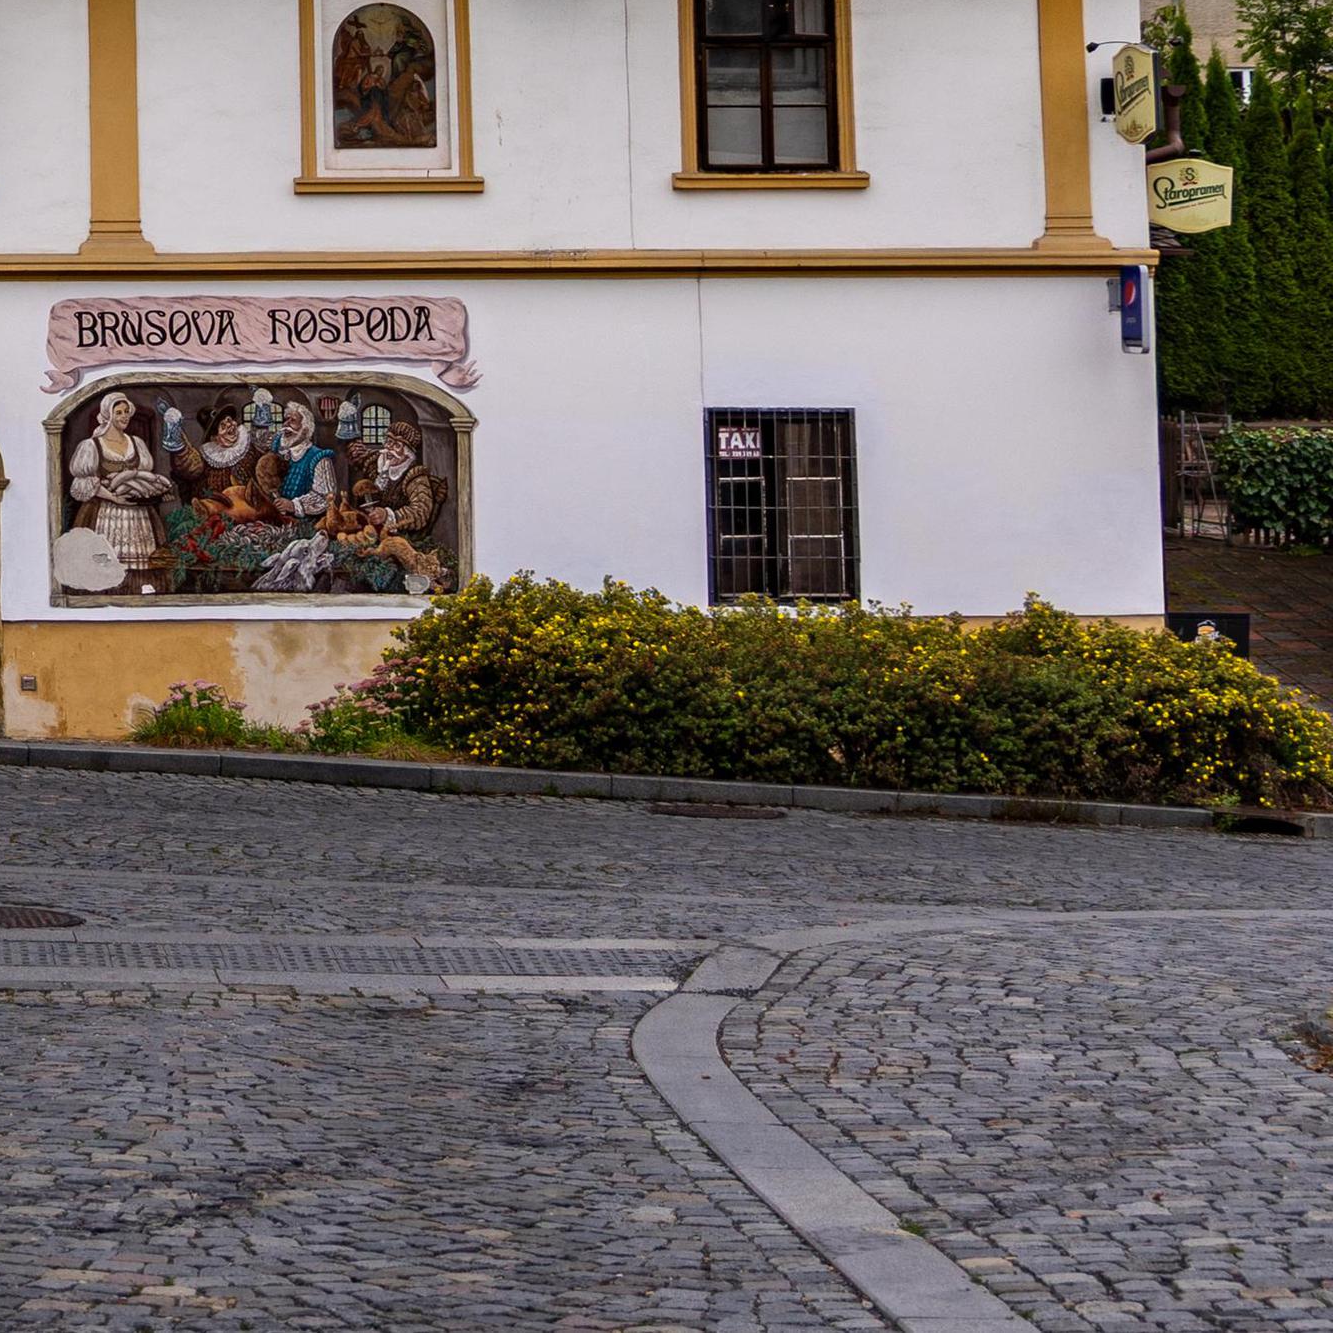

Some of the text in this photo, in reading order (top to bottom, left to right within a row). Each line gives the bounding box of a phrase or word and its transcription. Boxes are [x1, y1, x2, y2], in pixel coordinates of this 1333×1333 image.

[1154, 176, 1226, 208] Staropramen
[74, 306, 435, 349] BRUSOVA HOSPODA
